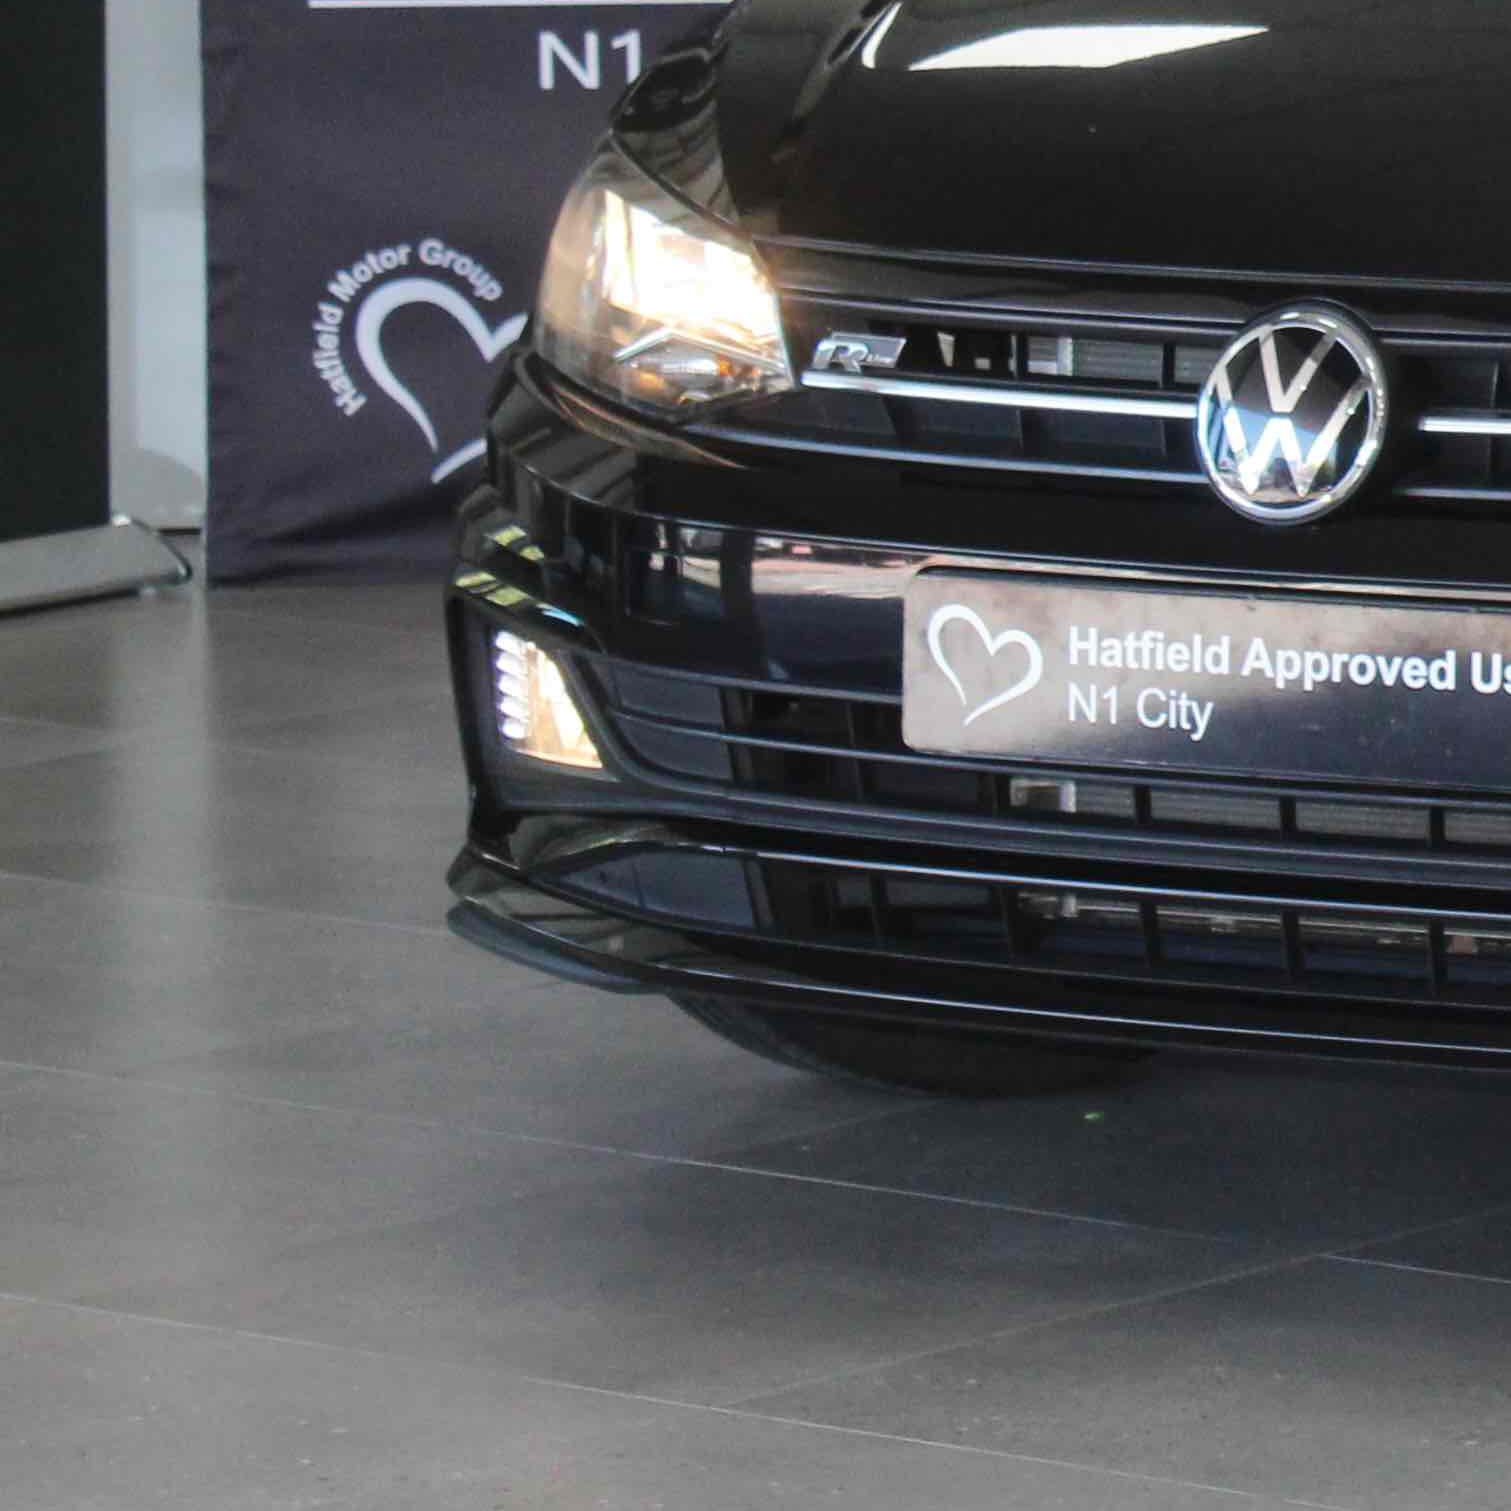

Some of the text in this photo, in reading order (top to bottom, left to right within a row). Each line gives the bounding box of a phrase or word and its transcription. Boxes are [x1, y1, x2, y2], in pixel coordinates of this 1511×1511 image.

[539, 30, 641, 90] N1
[312, 238, 502, 416] Hatfield Motor Group
[1068, 625, 1231, 675] Hatfield
[1241, 636, 1455, 691] Approved
[1067, 680, 1213, 740] N1 City
